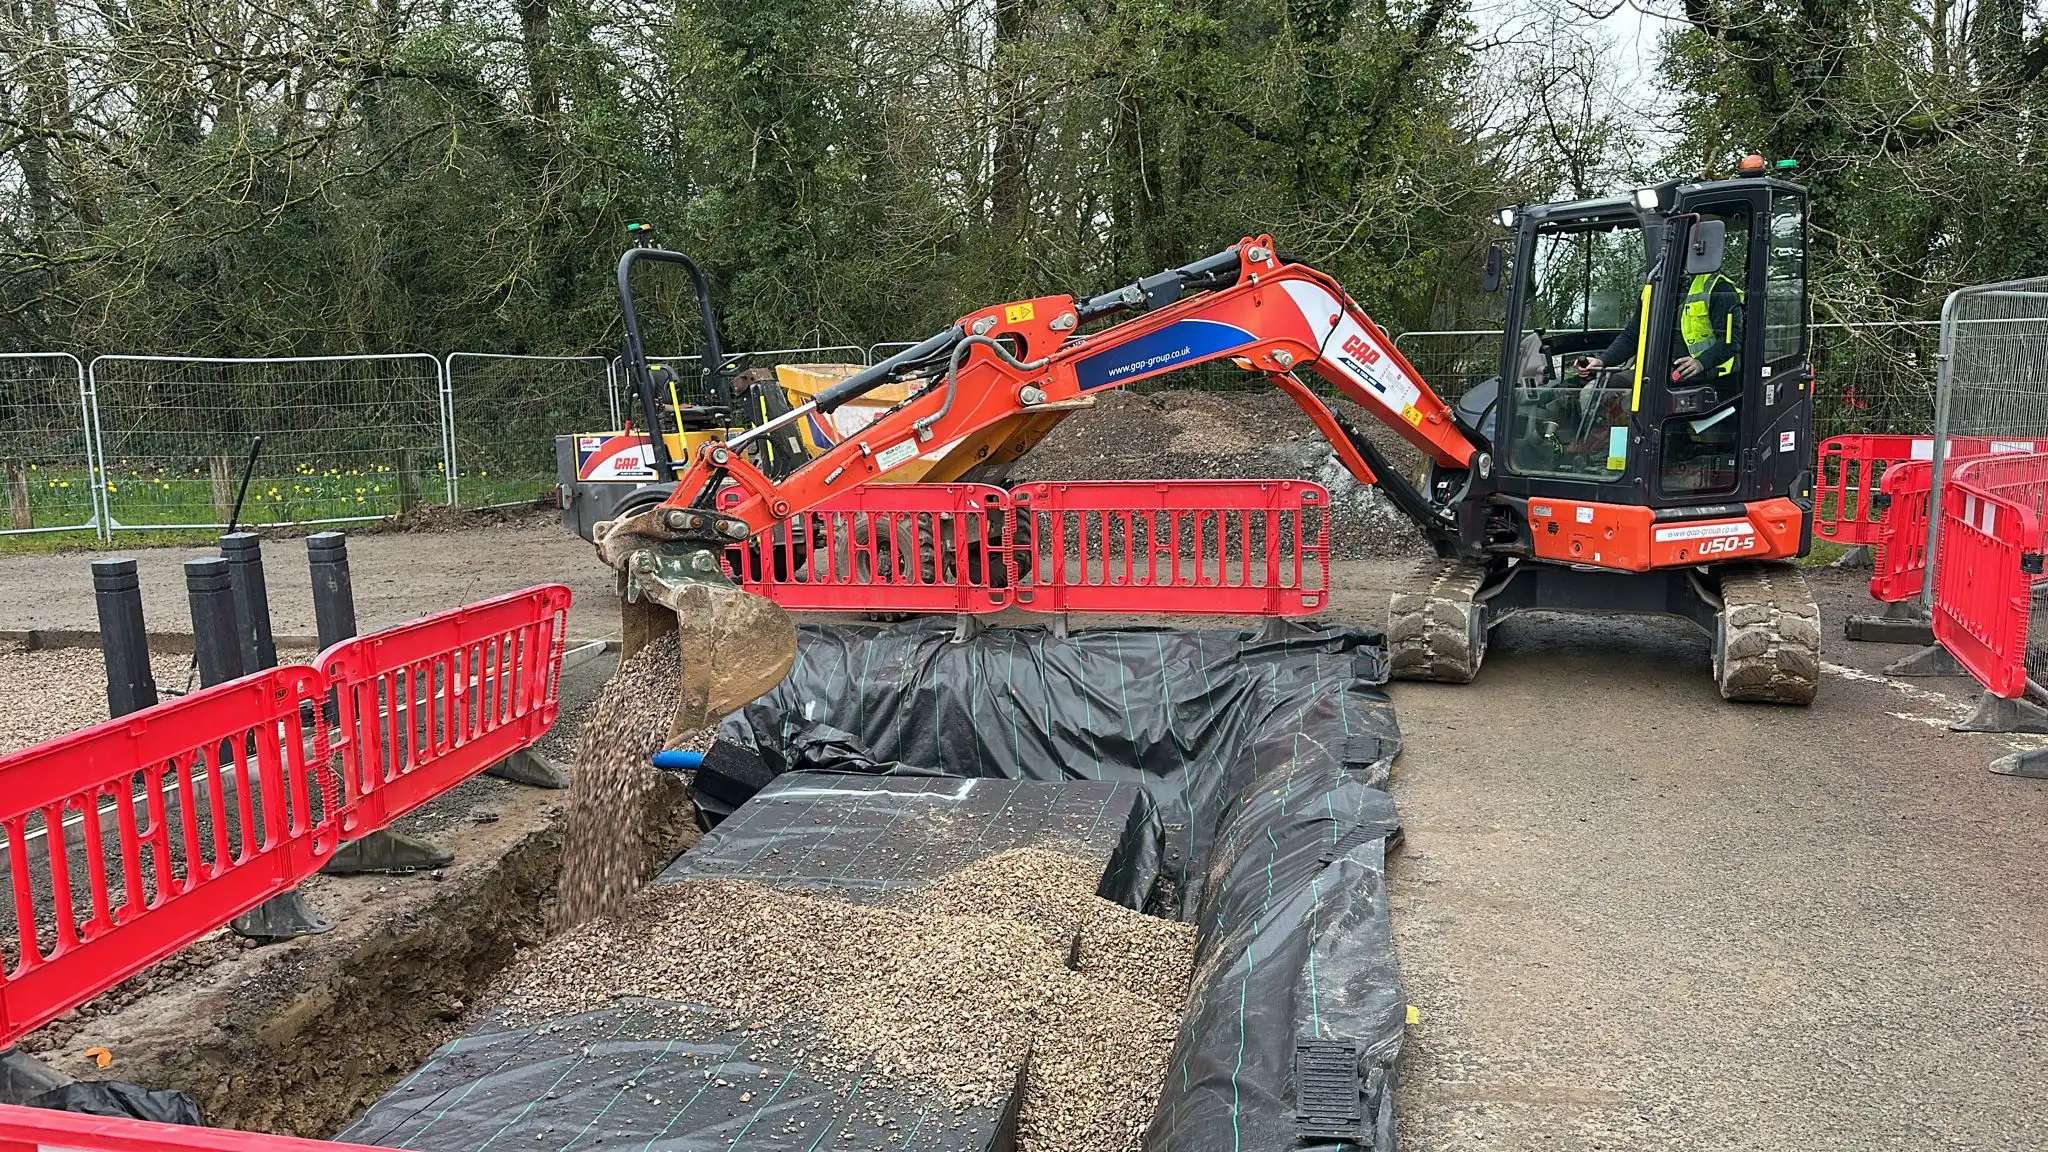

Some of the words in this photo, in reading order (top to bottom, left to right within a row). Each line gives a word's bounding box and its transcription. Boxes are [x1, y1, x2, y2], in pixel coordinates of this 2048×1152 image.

[1341, 334, 1380, 365] GAP
[1108, 345, 1191, 376] www.gap-group.co.uk
[614, 457, 639, 470] GAP
[1667, 524, 1739, 538] www.gap-group.co.uk
[1699, 536, 1755, 554] U50-5
